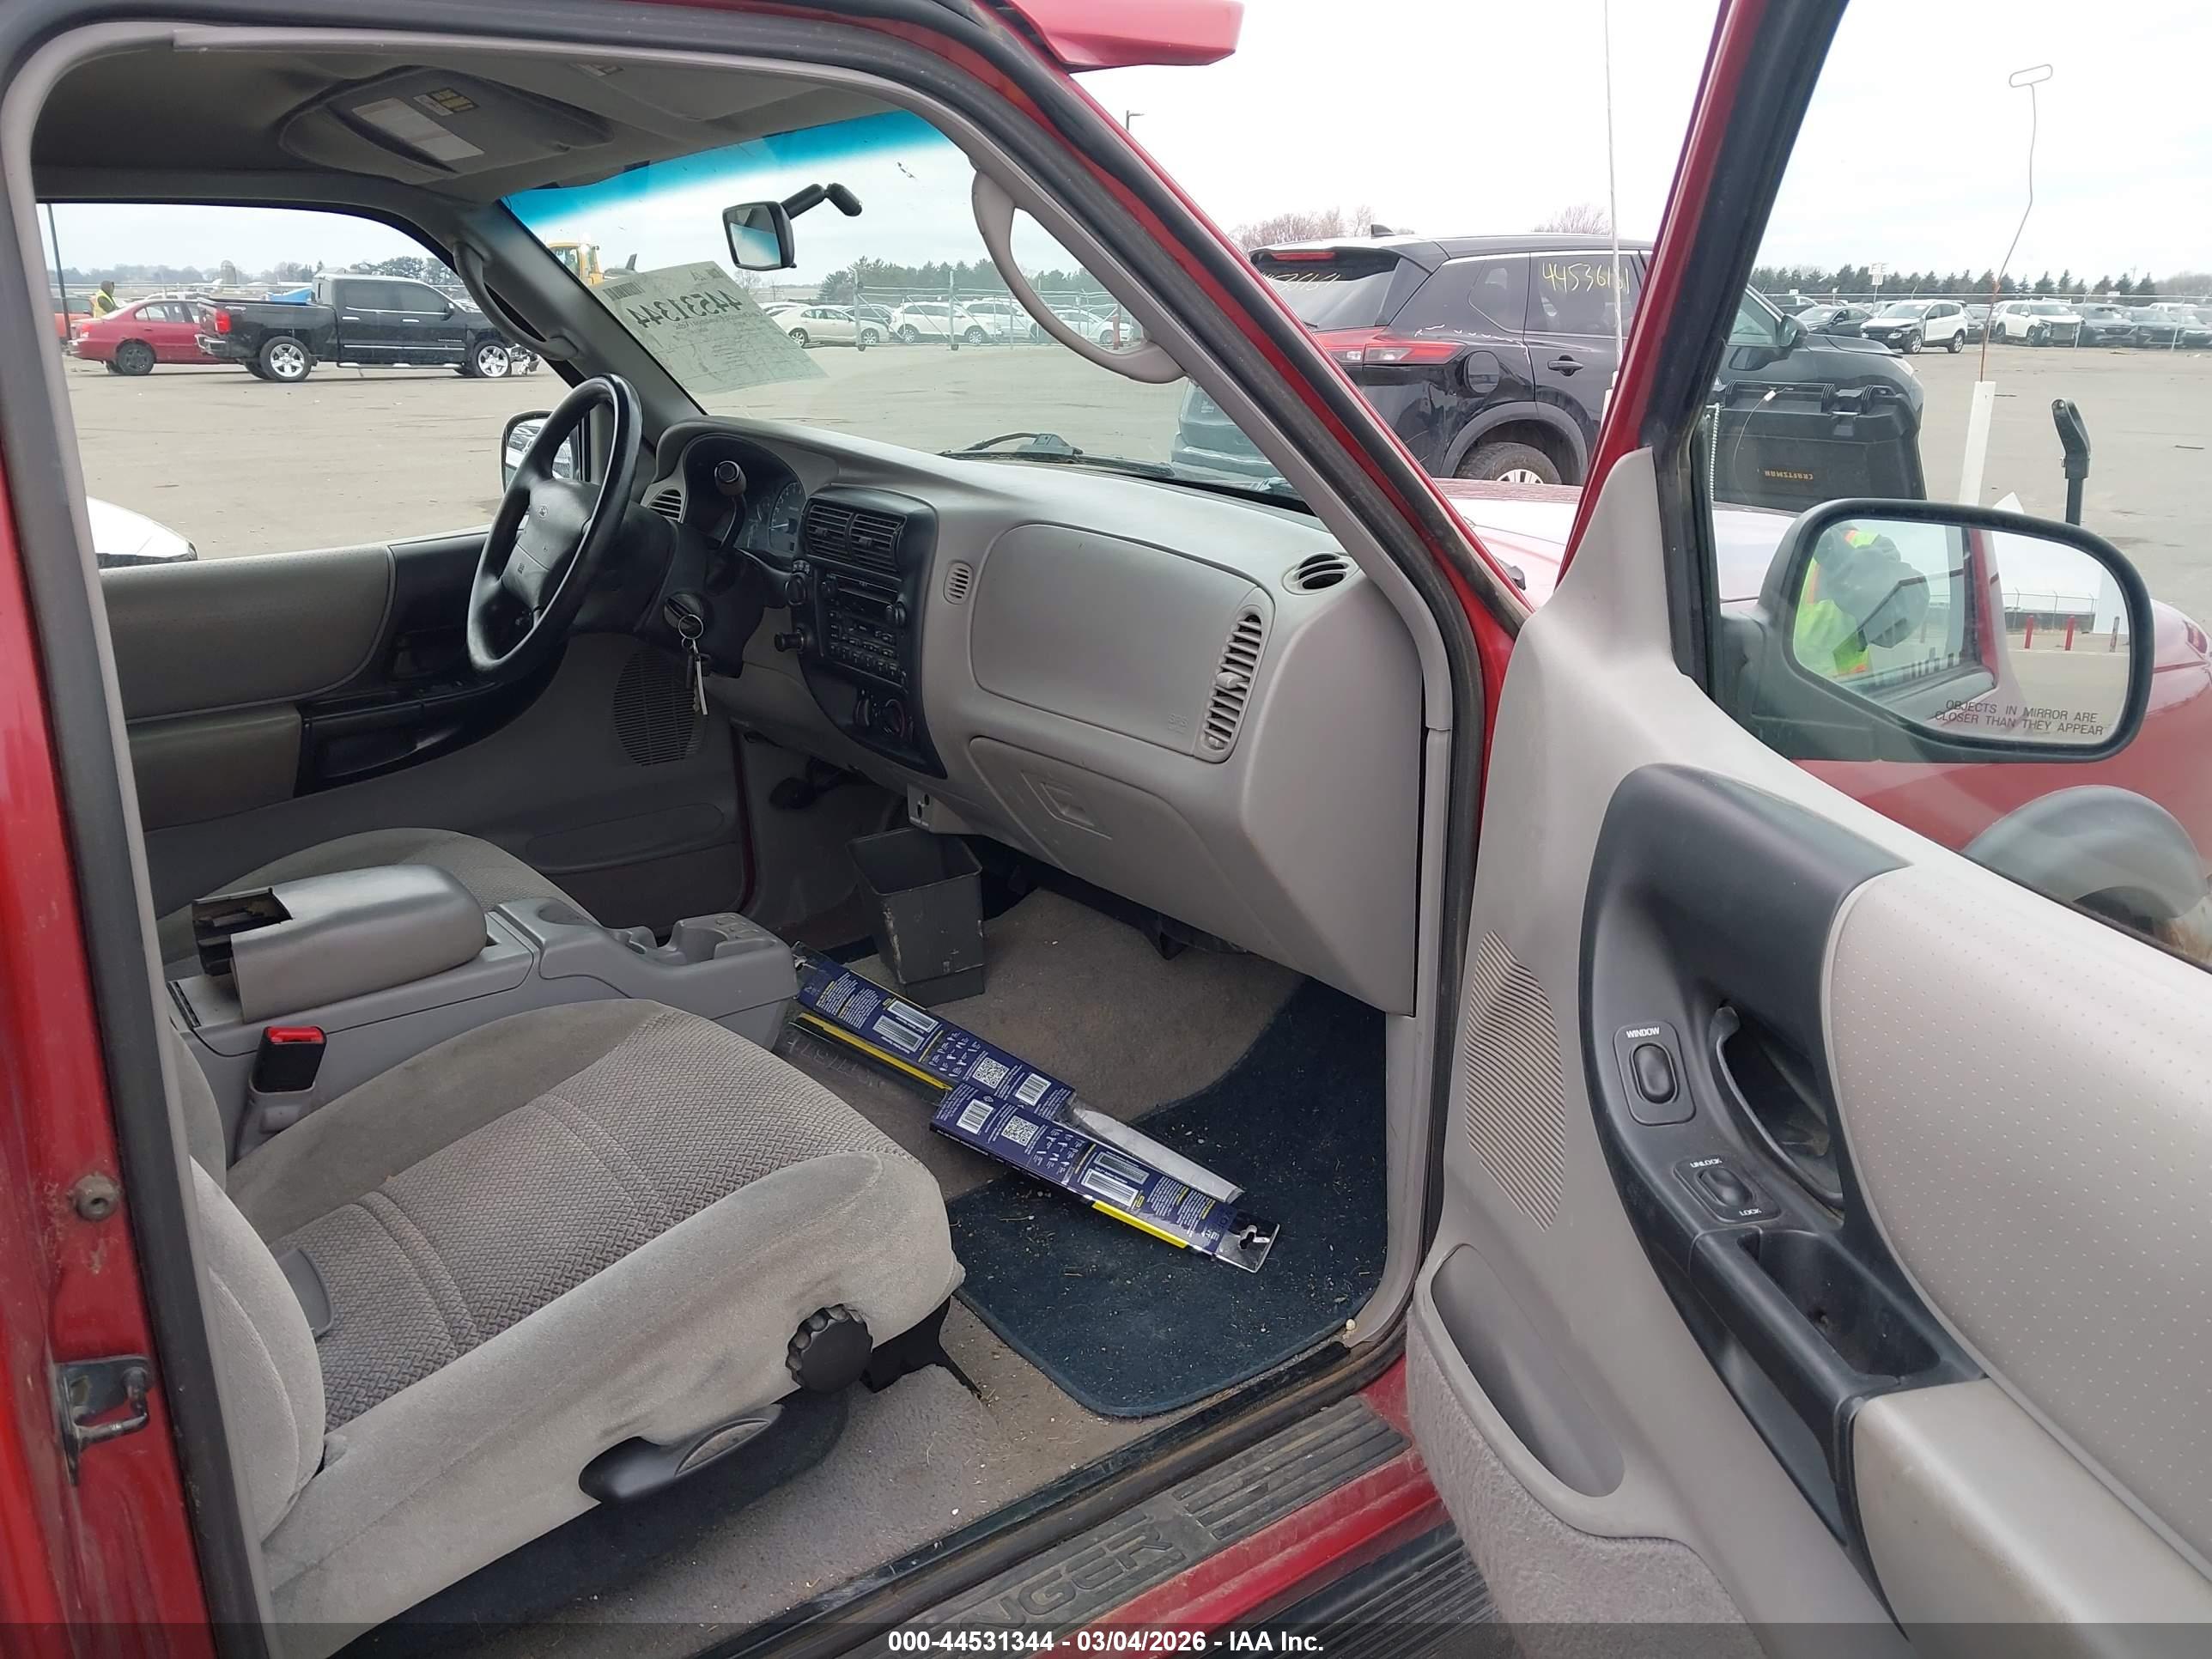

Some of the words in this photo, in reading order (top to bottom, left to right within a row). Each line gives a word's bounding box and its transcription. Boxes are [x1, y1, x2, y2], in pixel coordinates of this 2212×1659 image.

[1945, 699, 1998, 714] OBJECTS
[2005, 706, 2019, 715] IN
[2022, 707, 2069, 721] MIRROR
[2074, 712, 2099, 723] ARE
[1935, 710, 1979, 725] CLOSER
[1985, 715, 2017, 728] THAN
[2022, 719, 2052, 731] THEY
[2057, 722, 2104, 736] APPEAR
[1626, 1026, 1660, 1039] WINDOW
[1689, 1158, 1723, 1169] UNLOCK
[1738, 1207, 1762, 1217] LOCK
